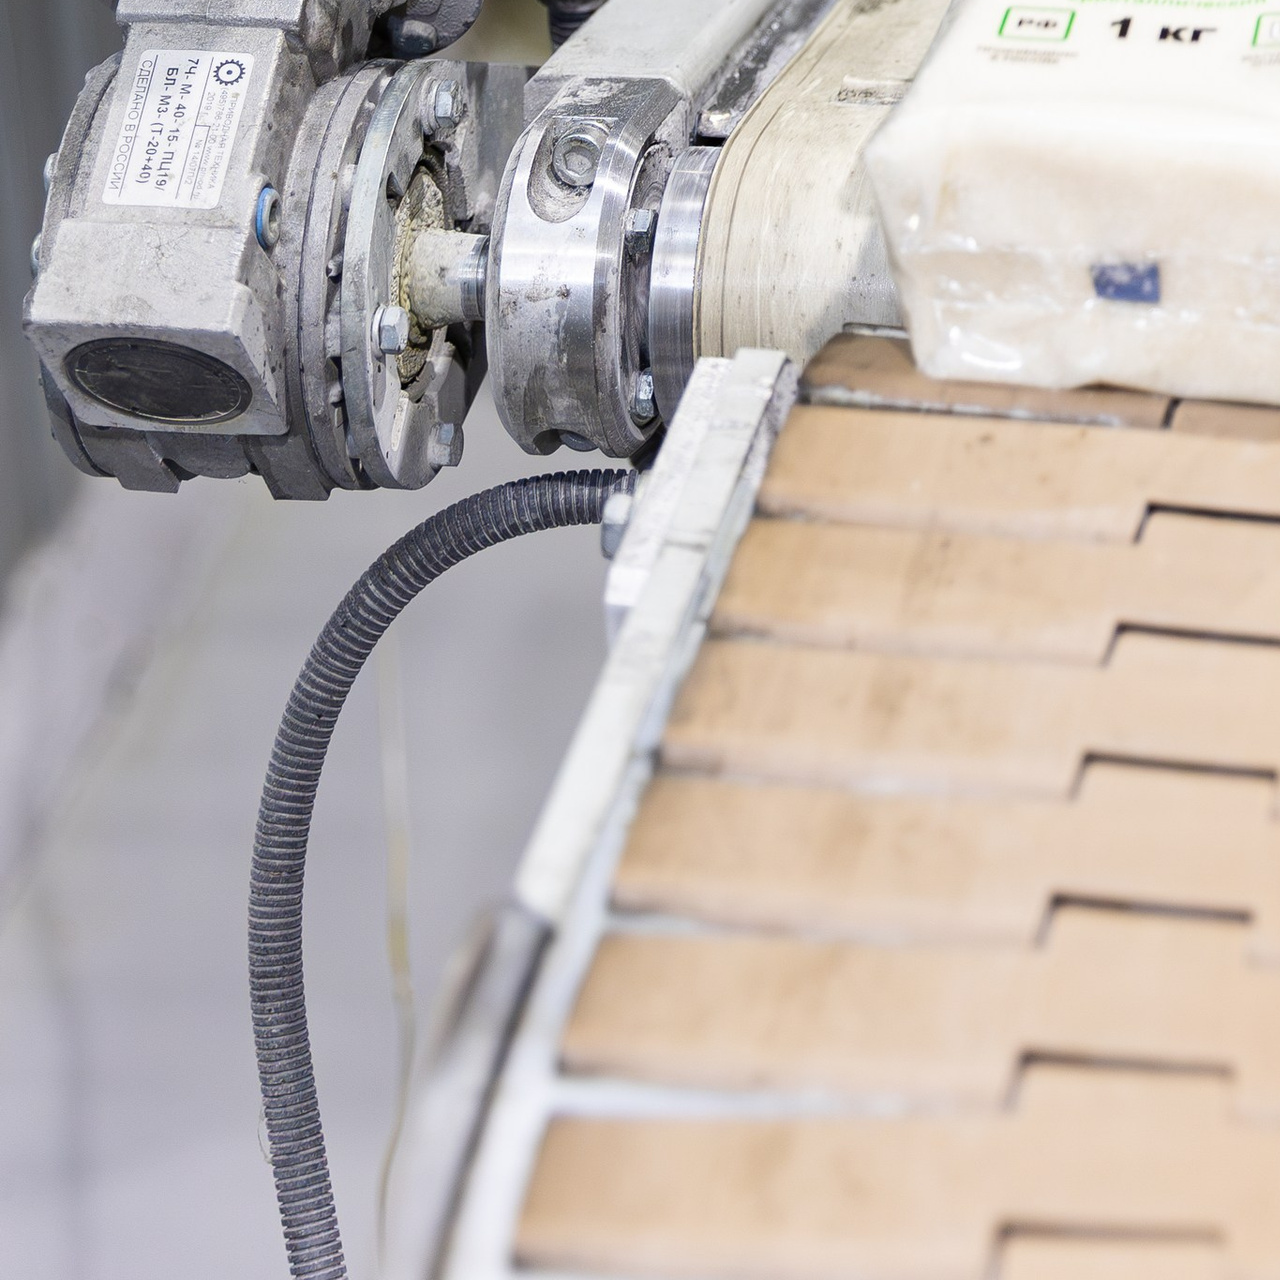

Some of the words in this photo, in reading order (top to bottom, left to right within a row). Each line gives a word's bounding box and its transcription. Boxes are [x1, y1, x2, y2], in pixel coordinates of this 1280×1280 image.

[1017, 16, 1057, 29] РФ
[1111, 16, 1132, 39] 1
[1158, 25, 1218, 43] кг
[163, 67, 179, 91] БЛ-
[184, 58, 200, 80] 7Ч-
[128, 59, 154, 120] СДЕЛАНО
[179, 83, 193, 100] М-
[156, 95, 172, 119] М3-
[173, 103, 187, 123] 40-
[124, 124, 136, 132] В
[167, 127, 180, 147] 15-
[109, 135, 133, 190] РОССИИ
[135, 122, 164, 184] (Т-20+40)
[155, 151, 175, 191] ПЦ19/
